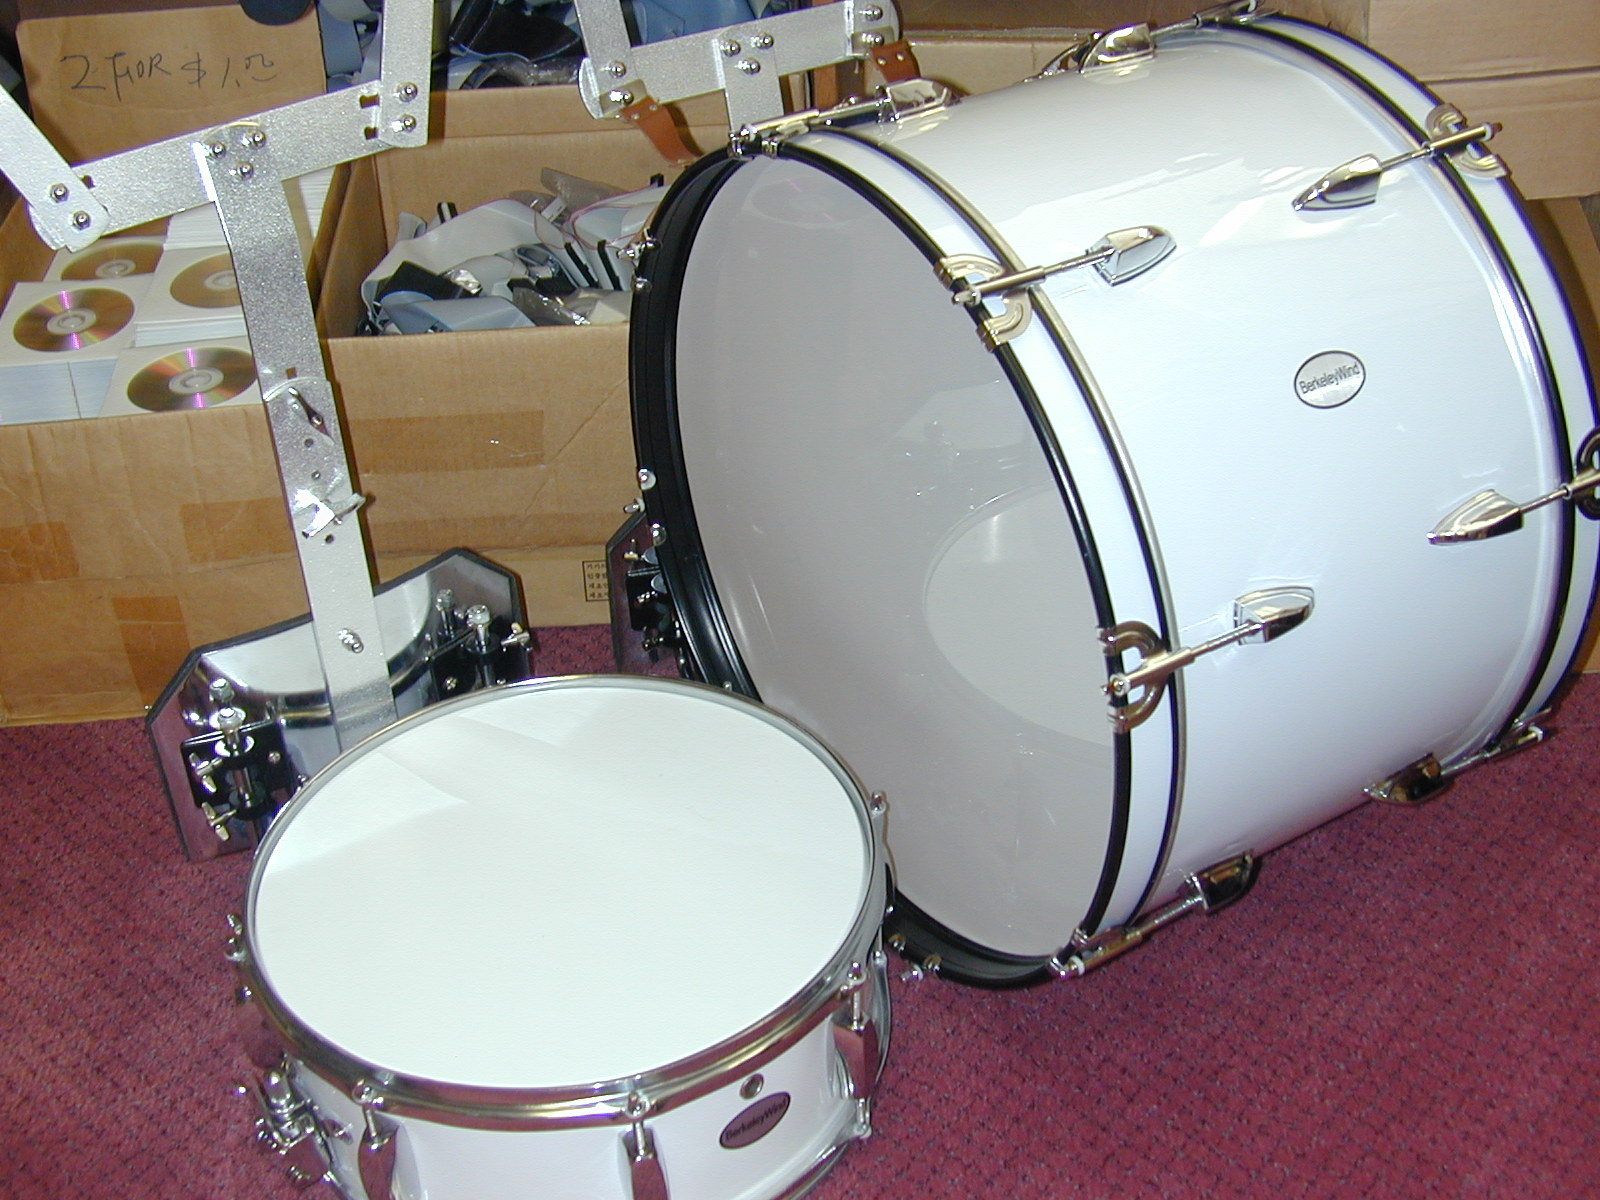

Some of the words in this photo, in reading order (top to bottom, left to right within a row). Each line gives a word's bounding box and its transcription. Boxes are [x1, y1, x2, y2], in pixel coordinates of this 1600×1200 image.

[60, 54, 105, 90] 2
[105, 52, 171, 101] FOR
[1299, 362, 1360, 394] BerkeleyWind
